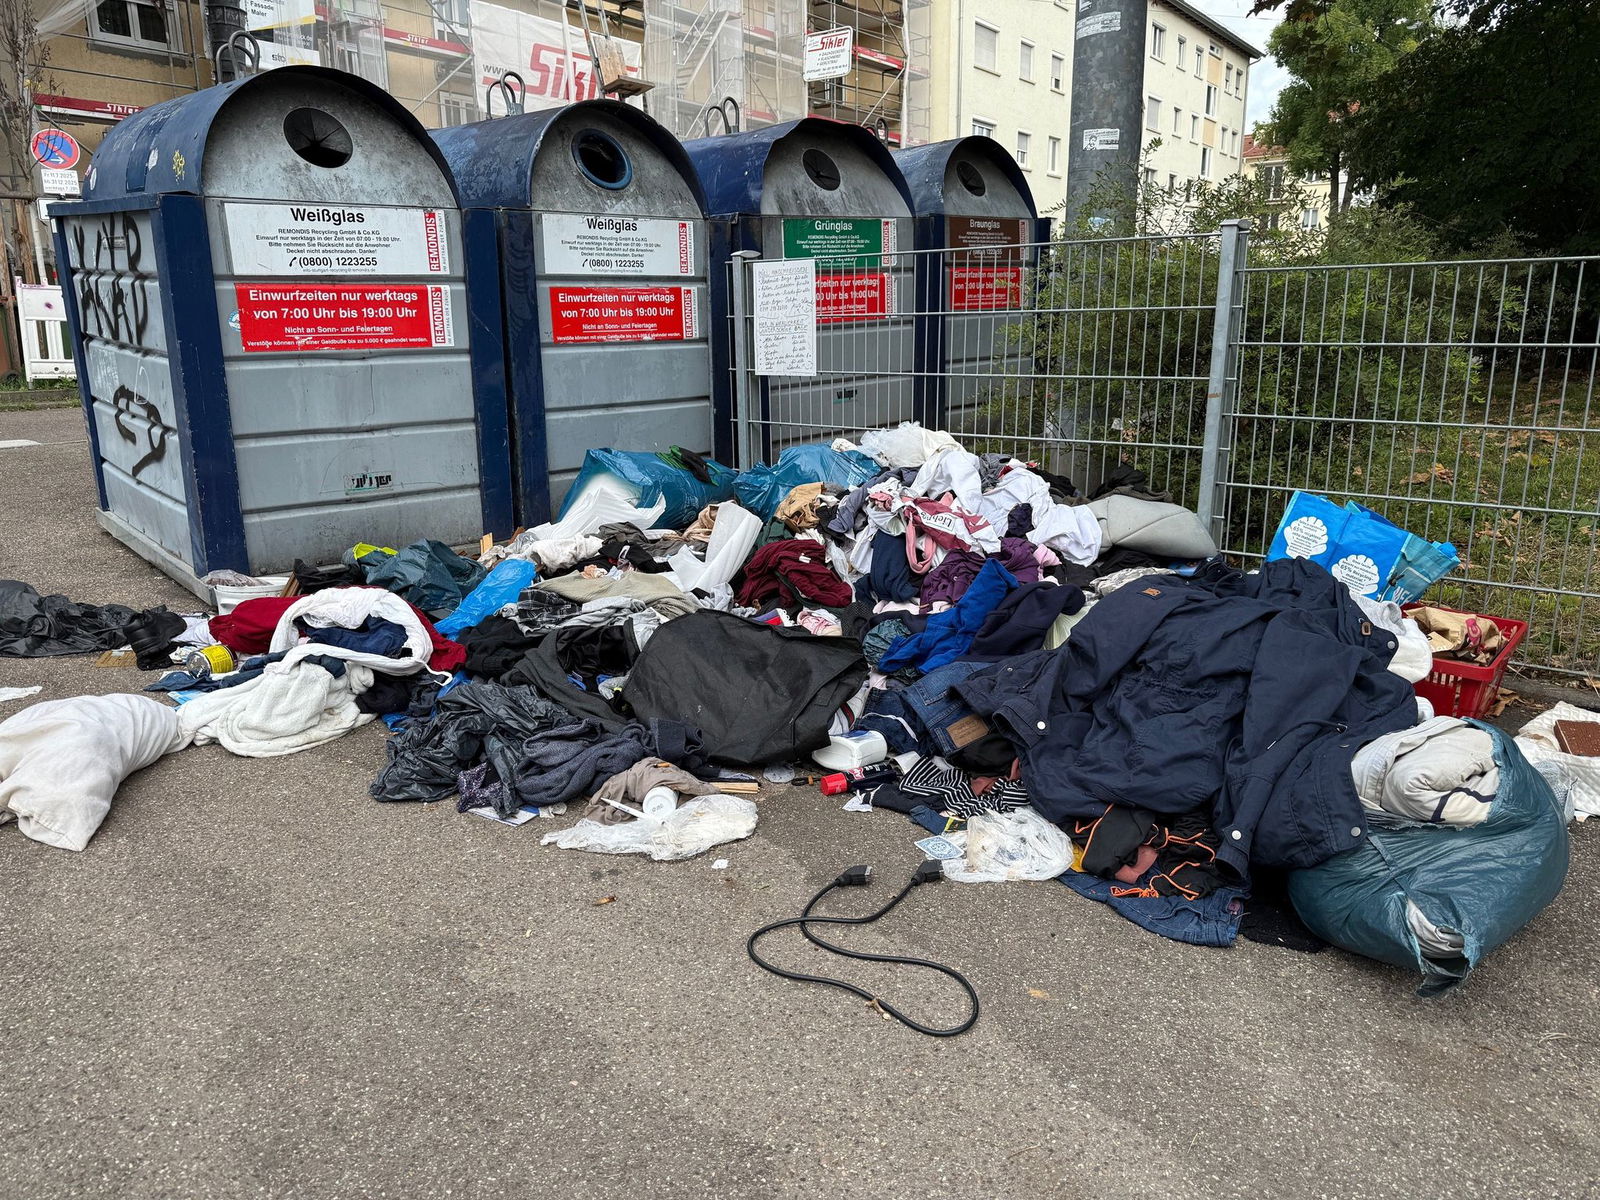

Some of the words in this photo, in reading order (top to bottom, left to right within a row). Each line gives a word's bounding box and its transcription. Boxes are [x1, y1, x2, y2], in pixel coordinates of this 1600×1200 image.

[250, 1, 274, 11] Fassade
[251, 9, 267, 17] Maler
[820, 36, 848, 50] Sikler
[290, 208, 365, 226] Weißglas
[586, 218, 638, 234] Weißglas
[814, 220, 853, 232] Grünglas
[970, 219, 1000, 230] Braunglas
[311, 228, 338, 237] Recycling
[425, 216, 440, 271] REMONDIS
[679, 227, 688, 274] REMONDIS
[298, 256, 332, 268] (0800)
[336, 257, 378, 266] 1223255
[588, 258, 613, 269] (0800)
[614, 260, 645, 268] 1223255
[249, 290, 338, 301] Einwurfzeiten
[341, 292, 362, 301] nur
[364, 289, 418, 304] werktags
[558, 292, 619, 303] Einwurfzeiten
[621, 294, 636, 302] nur
[638, 292, 675, 304] werktags
[826, 292, 838, 300] Uhr
[868, 290, 879, 298] Uhr
[253, 310, 278, 319] von
[280, 308, 310, 319] 7:00
[312, 308, 336, 318] Uhr
[339, 308, 358, 318] bis
[362, 307, 393, 318] 19:00
[396, 306, 418, 318] Uhr
[432, 290, 446, 343] REMONDIS
[560, 310, 578, 318] von
[580, 308, 600, 318] 7:00
[602, 308, 618, 318] Uhr
[620, 307, 634, 317] bis
[636, 306, 658, 316] 19:00
[660, 306, 674, 316] Uhr
[684, 292, 693, 338] REMONDIS
[284, 326, 305, 334] Nicht
[632, 322, 658, 330] Feiertagen
[1340, 564, 1352, 572] 65%
